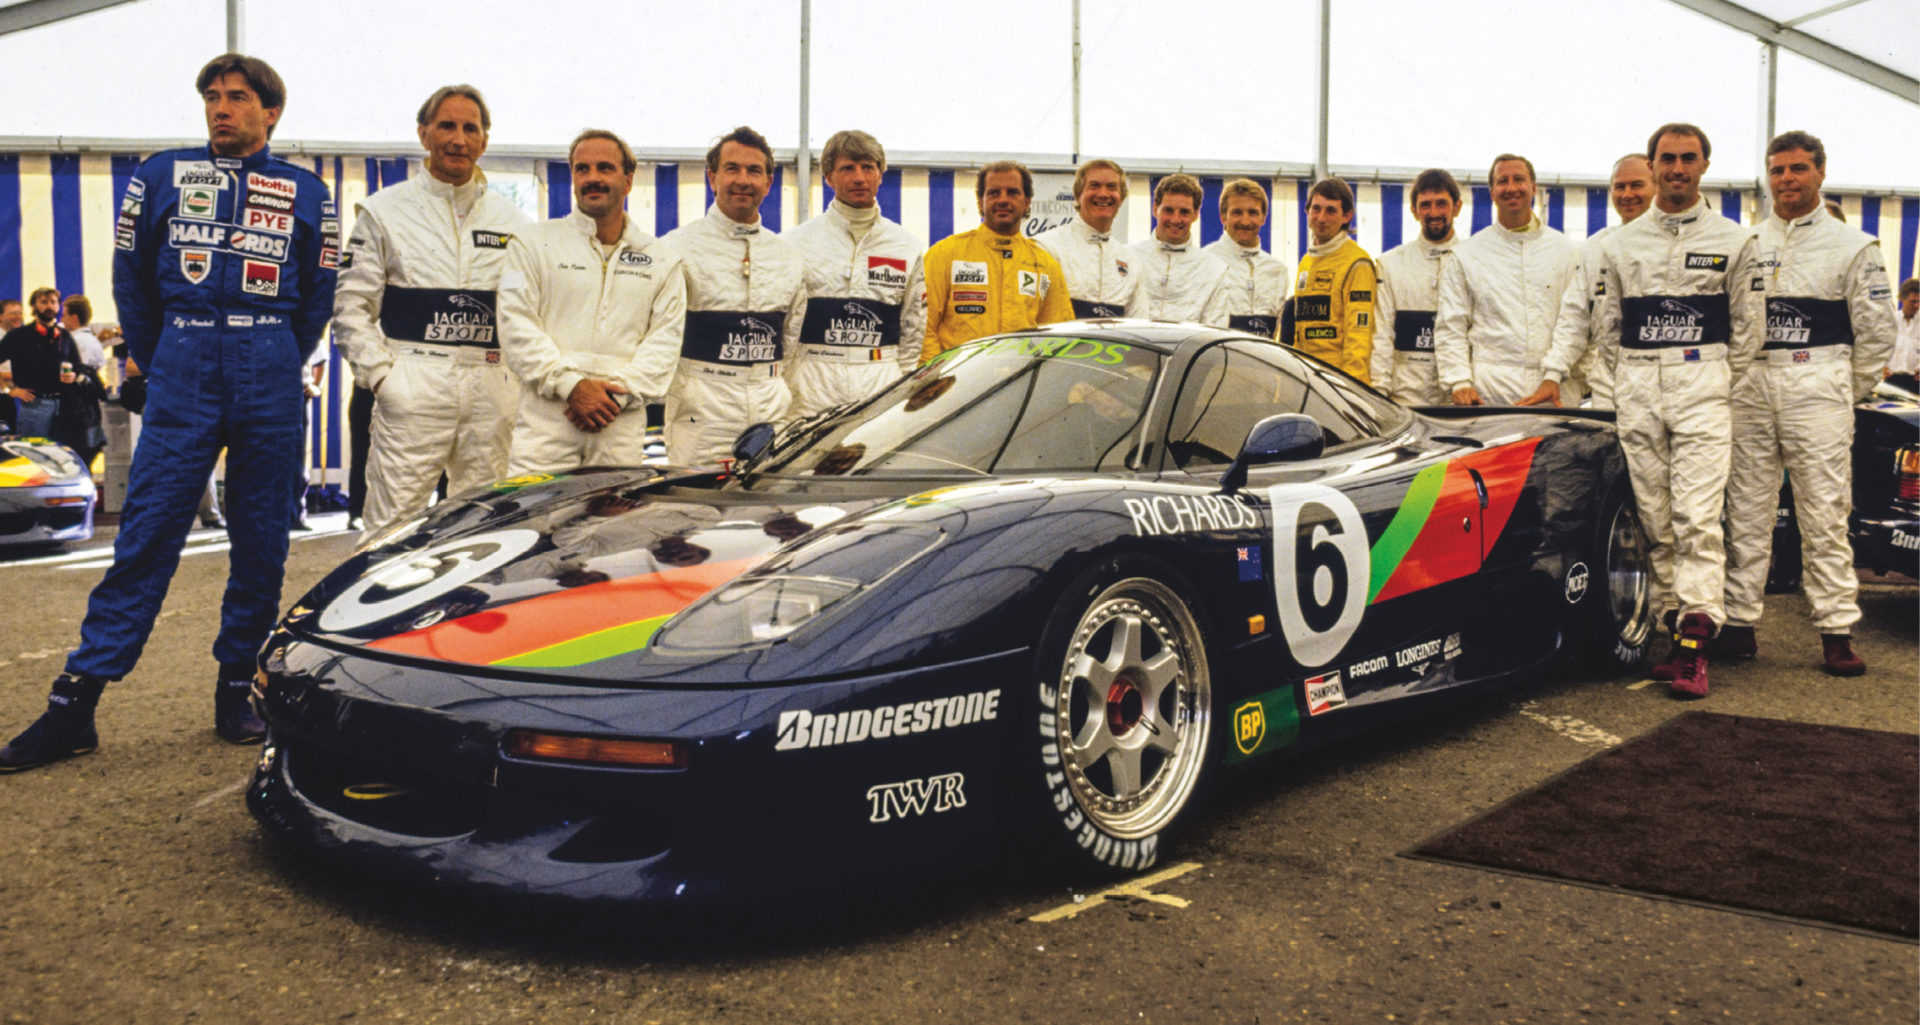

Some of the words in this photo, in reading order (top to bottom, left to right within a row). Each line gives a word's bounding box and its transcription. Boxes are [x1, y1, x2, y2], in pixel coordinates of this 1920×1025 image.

[181, 176, 221, 185] SPORT
[248, 193, 293, 210] CANNON
[249, 211, 289, 231] PYE
[477, 233, 500, 246] INTER
[620, 249, 651, 265] Arai
[1688, 256, 1713, 266] INTER
[868, 268, 906, 283] Marlboro
[955, 275, 984, 283] SPORT
[434, 312, 489, 326] JAGUAR
[831, 317, 876, 331] JAGUAR
[1647, 314, 1696, 328] JAGUAR
[1767, 315, 1803, 328] GUAR
[428, 325, 492, 341] SPORT
[728, 332, 773, 345] JAGUAR
[827, 330, 879, 345] SPORT
[1641, 327, 1699, 341] SPORT
[722, 345, 775, 359] SPORT
[1124, 494, 1256, 537] RICHARDS
[1295, 502, 1349, 634] 6
[1395, 639, 1442, 667] LONGINES
[1310, 683, 1340, 702] CHAMPION
[774, 689, 1001, 751] BRIDGESTONE
[1240, 711, 1262, 742] BP
[1039, 682, 1159, 871] BRIDGESTONE
[866, 772, 967, 822] TWR
